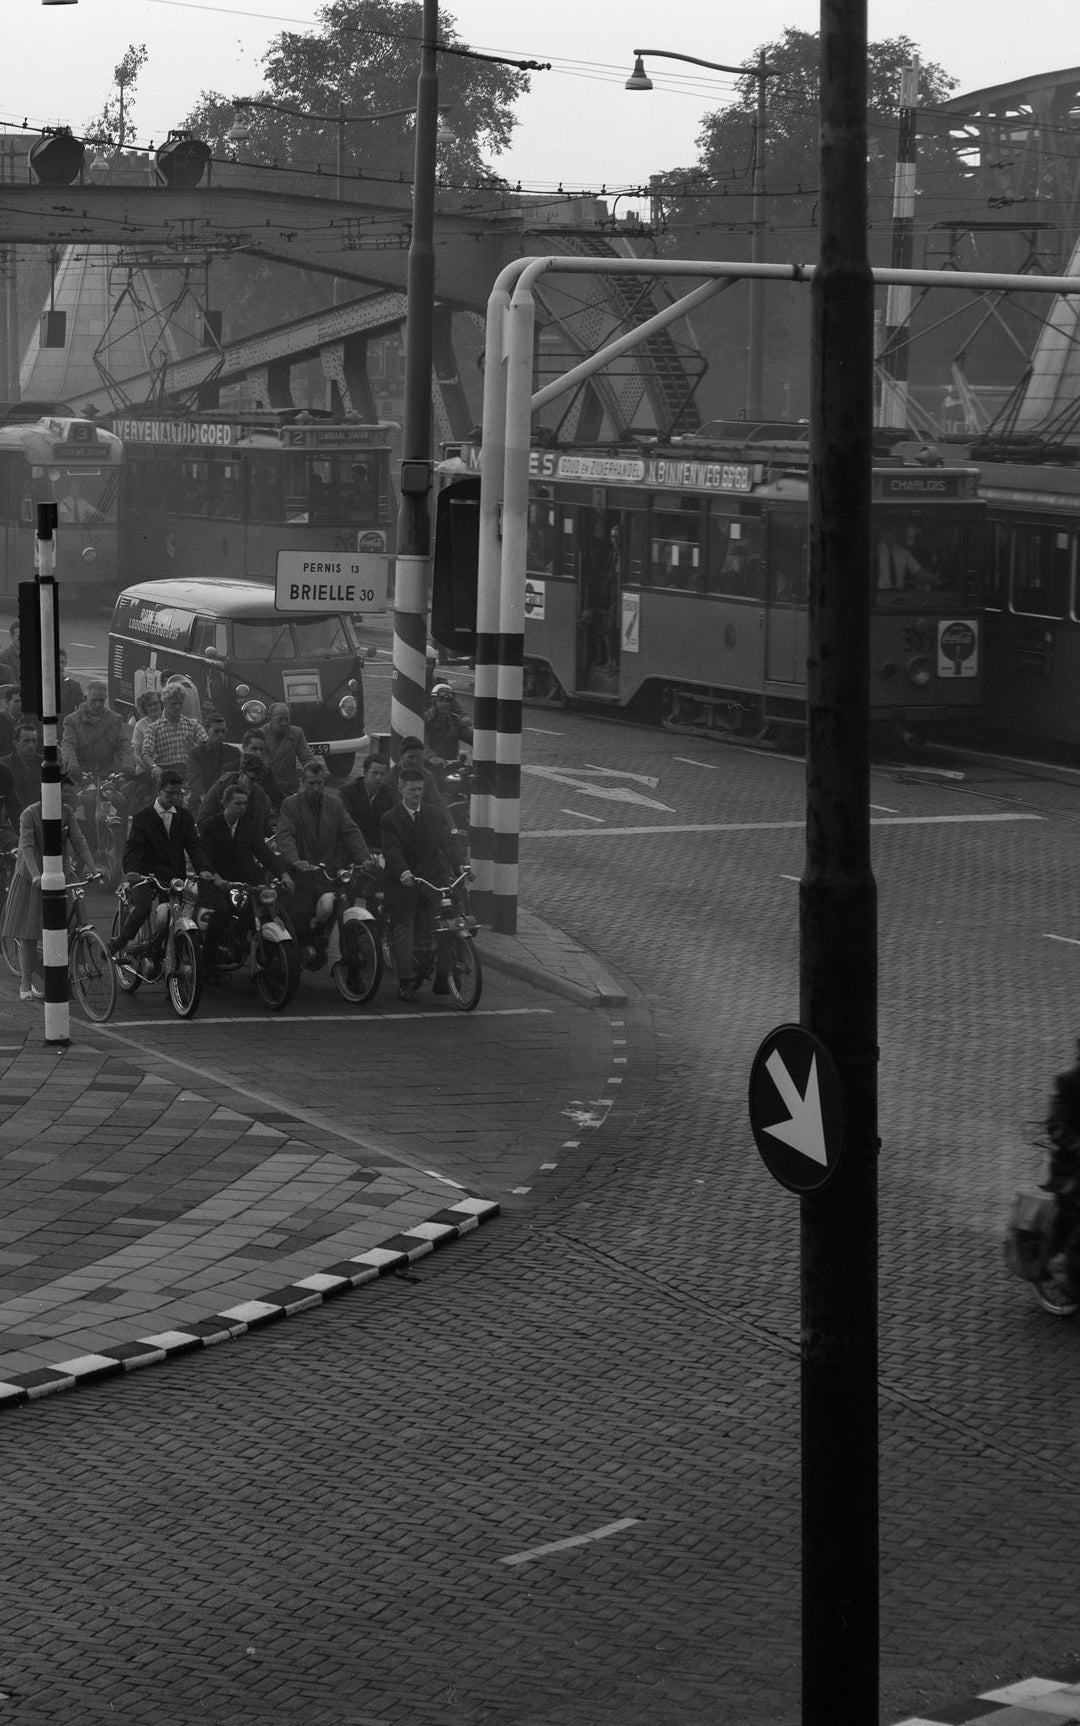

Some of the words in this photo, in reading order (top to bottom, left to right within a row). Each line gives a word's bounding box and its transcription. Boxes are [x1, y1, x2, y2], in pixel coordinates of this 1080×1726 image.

[76, 428, 88, 440] 3
[200, 424, 231, 445] GOED
[293, 431, 304, 445] 2
[889, 480, 946, 491] CHARLOIS
[303, 563, 342, 573] PERNIS
[351, 565, 360, 574] 13
[290, 584, 355, 601] BRIELLE
[359, 589, 374, 602] 30
